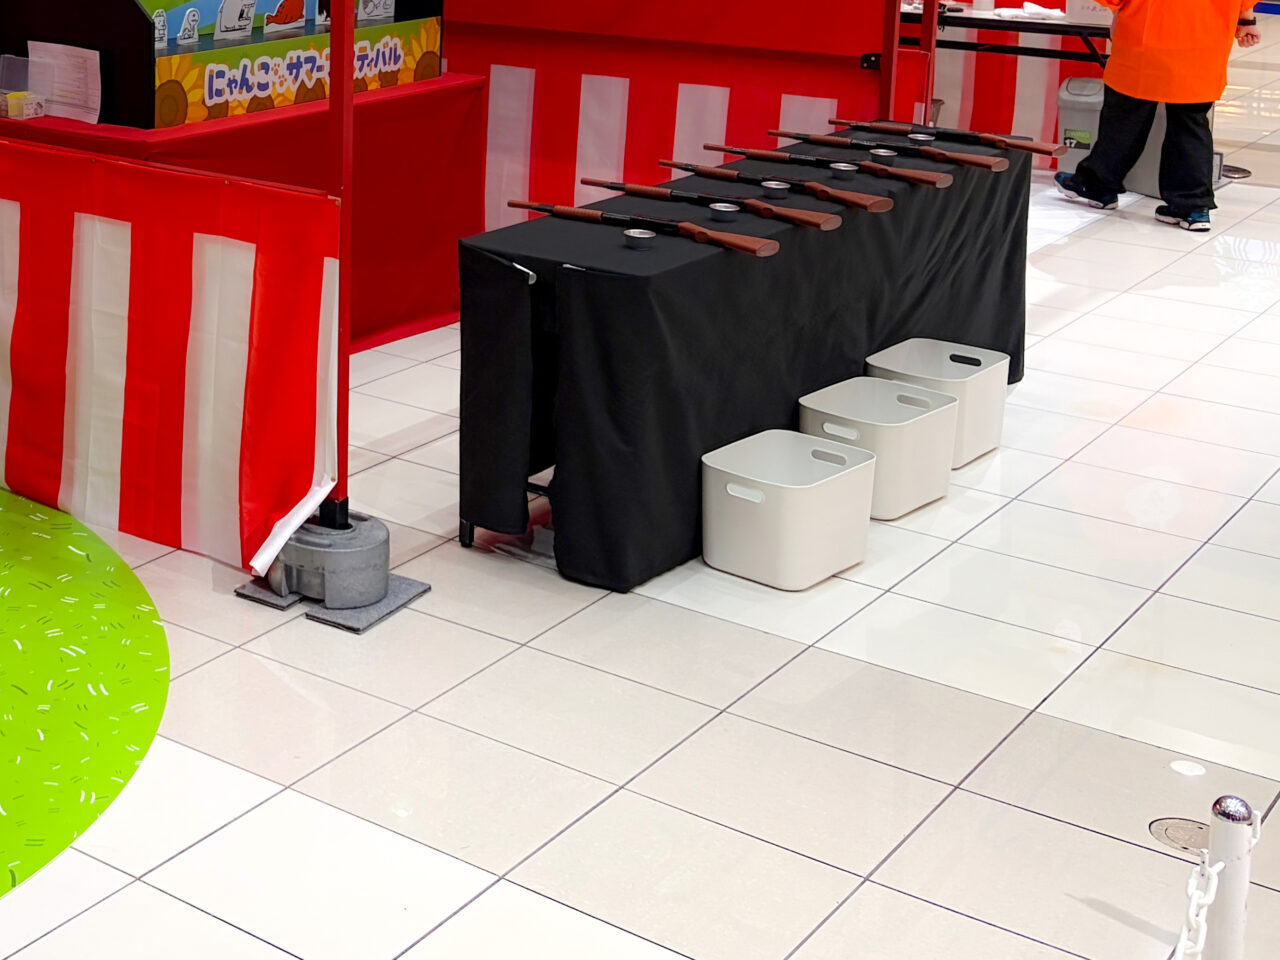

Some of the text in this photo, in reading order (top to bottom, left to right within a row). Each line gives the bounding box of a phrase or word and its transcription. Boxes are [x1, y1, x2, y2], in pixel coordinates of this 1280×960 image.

[207, 60, 271, 101] にゃんこ
[1065, 139, 1077, 148] 17
